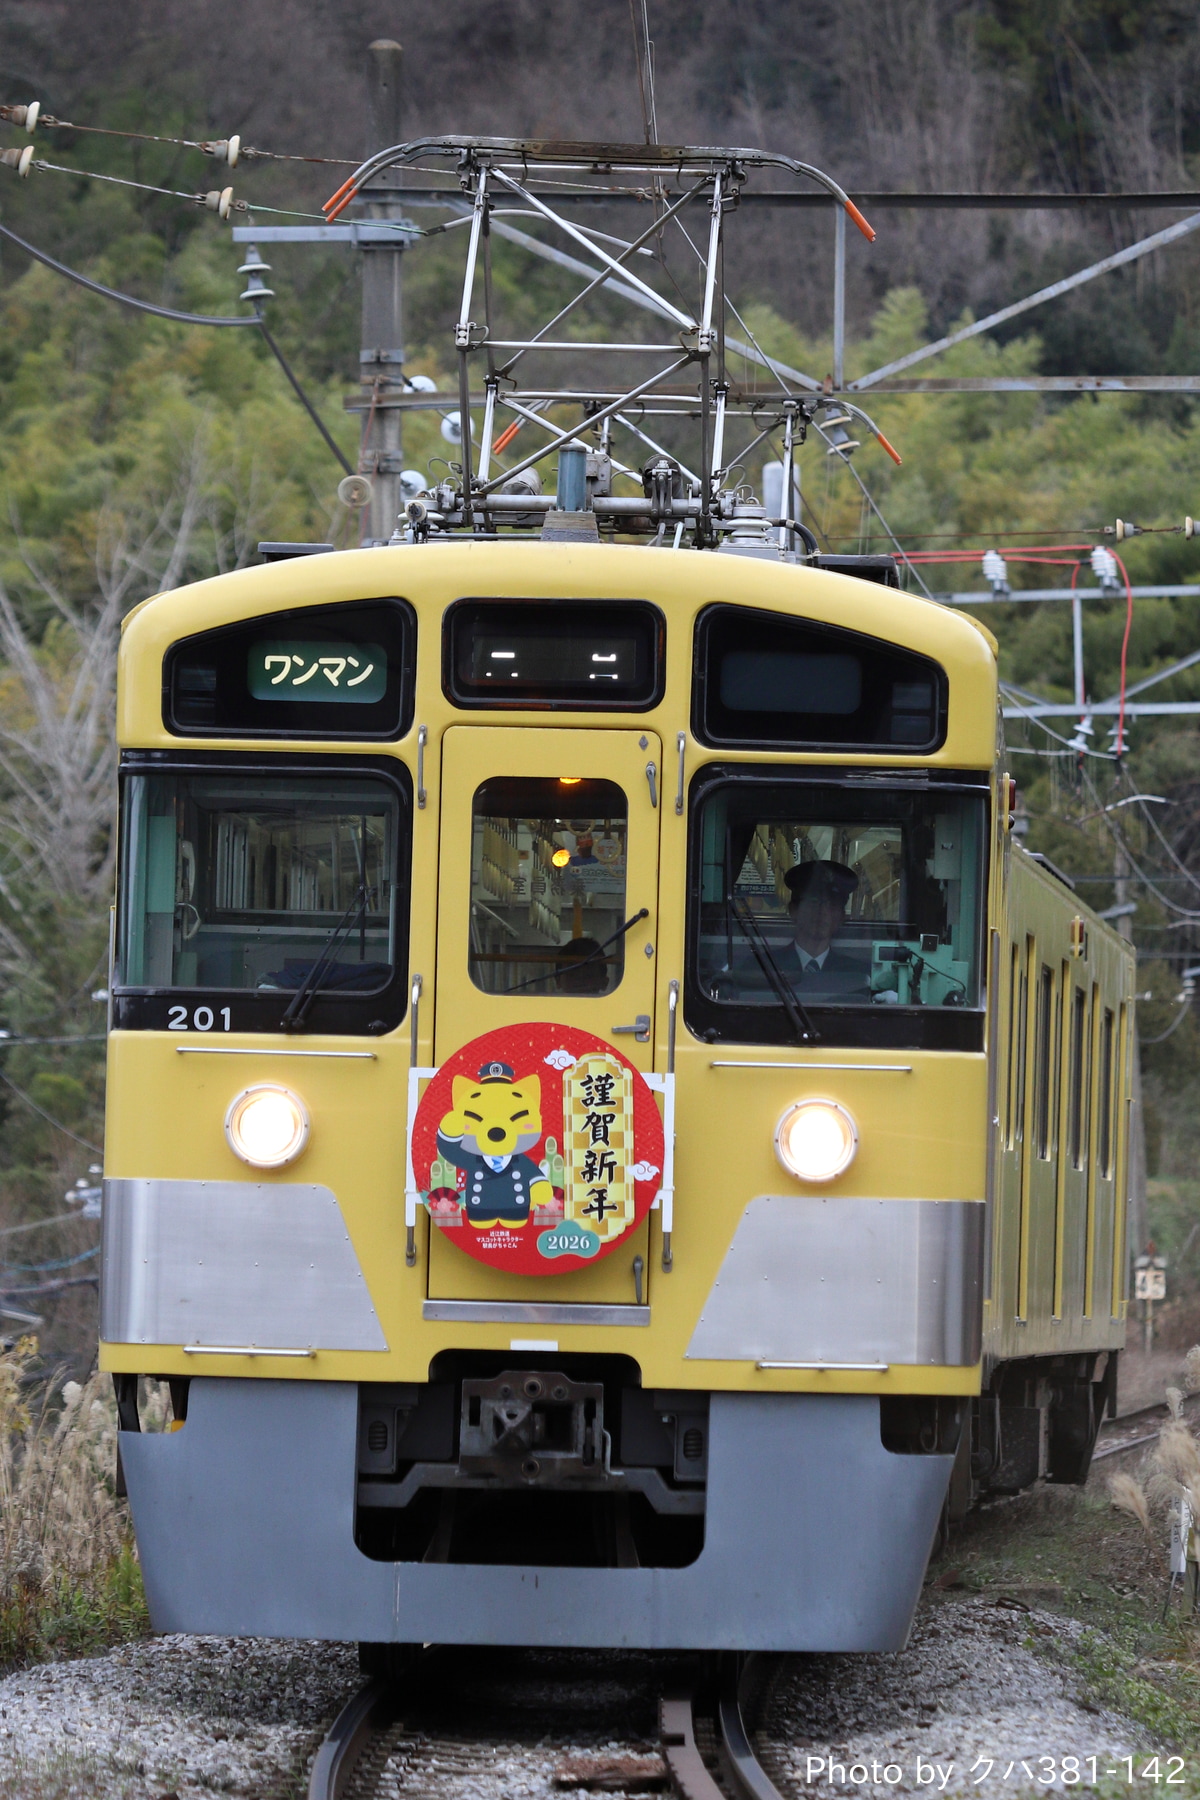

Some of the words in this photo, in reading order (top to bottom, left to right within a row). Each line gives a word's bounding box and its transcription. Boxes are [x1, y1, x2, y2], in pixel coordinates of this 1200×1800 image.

[264, 654, 375, 687] ワンマン
[167, 1006, 232, 1031] 201
[580, 1073, 618, 1223] 謹賀新年
[547, 1236, 590, 1250] 2026
